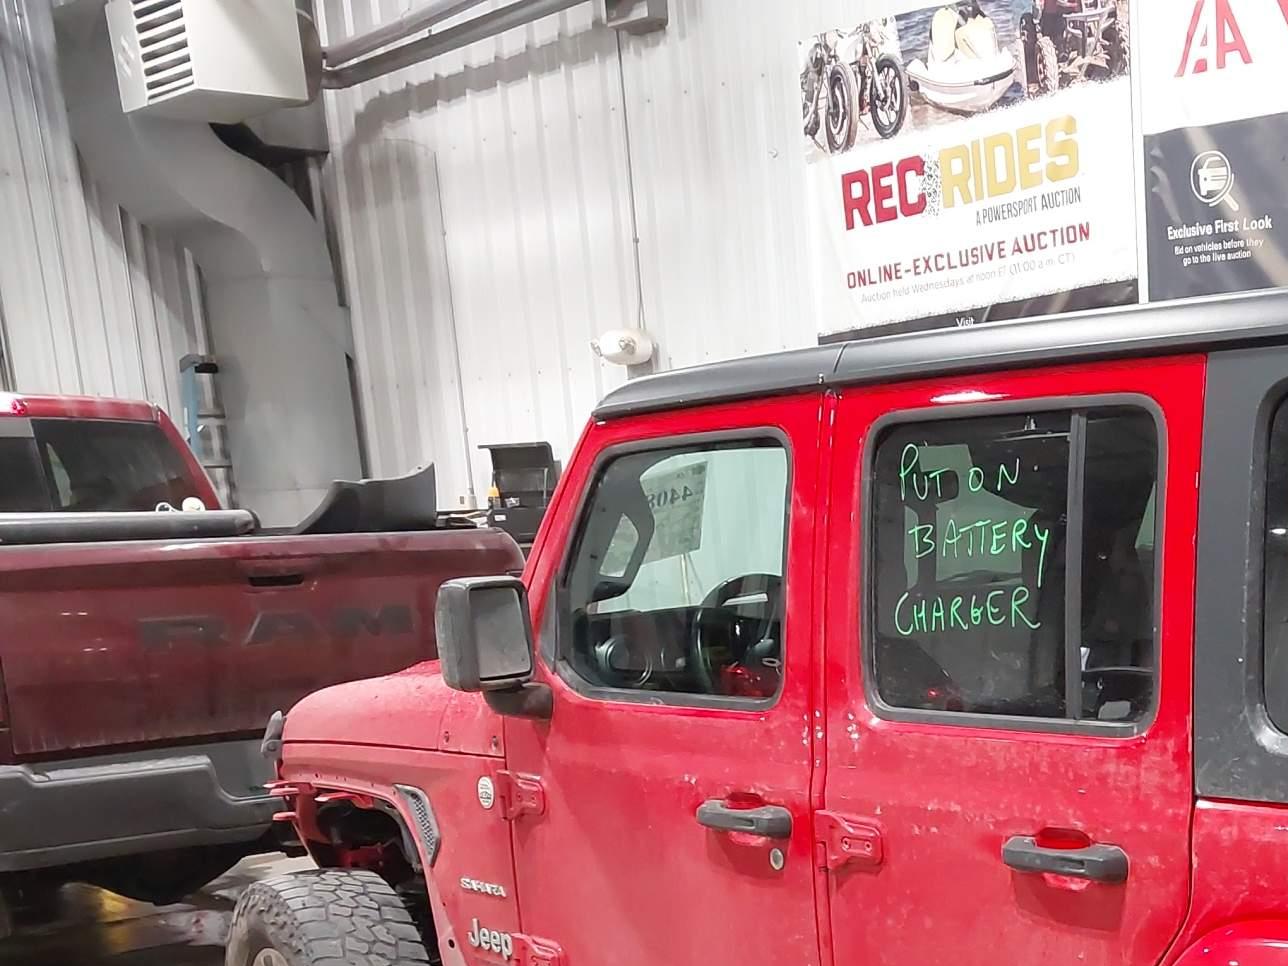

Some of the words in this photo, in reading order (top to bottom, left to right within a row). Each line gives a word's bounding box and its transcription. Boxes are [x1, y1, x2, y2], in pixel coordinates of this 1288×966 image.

[841, 155, 927, 231] REC
[939, 114, 1080, 209] RIDES
[975, 210, 982, 226] A
[982, 196, 1038, 225] POWERSPORT
[1041, 186, 1081, 211] AUCTION
[1167, 222, 1213, 240] Exclusive
[1214, 219, 1239, 234] First
[1242, 214, 1272, 231] Look
[847, 240, 1006, 289] ONLINE-EXCLUSIVE
[1010, 221, 1090, 256] AUCTION
[1182, 257, 1191, 267] go
[1192, 255, 1199, 264] to
[1200, 253, 1211, 263] the
[1212, 251, 1226, 262] live
[1227, 249, 1252, 260] auction
[1193, 241, 1222, 253] vehicles
[1222, 239, 1245, 249] before
[1246, 237, 1264, 249] they
[899, 443, 950, 501] PUT
[968, 457, 1020, 492] ON
[908, 518, 1049, 588] BATTERY
[138, 604, 421, 652] RAM
[894, 586, 1041, 636] CHARGER
[466, 917, 512, 961] Jeep
